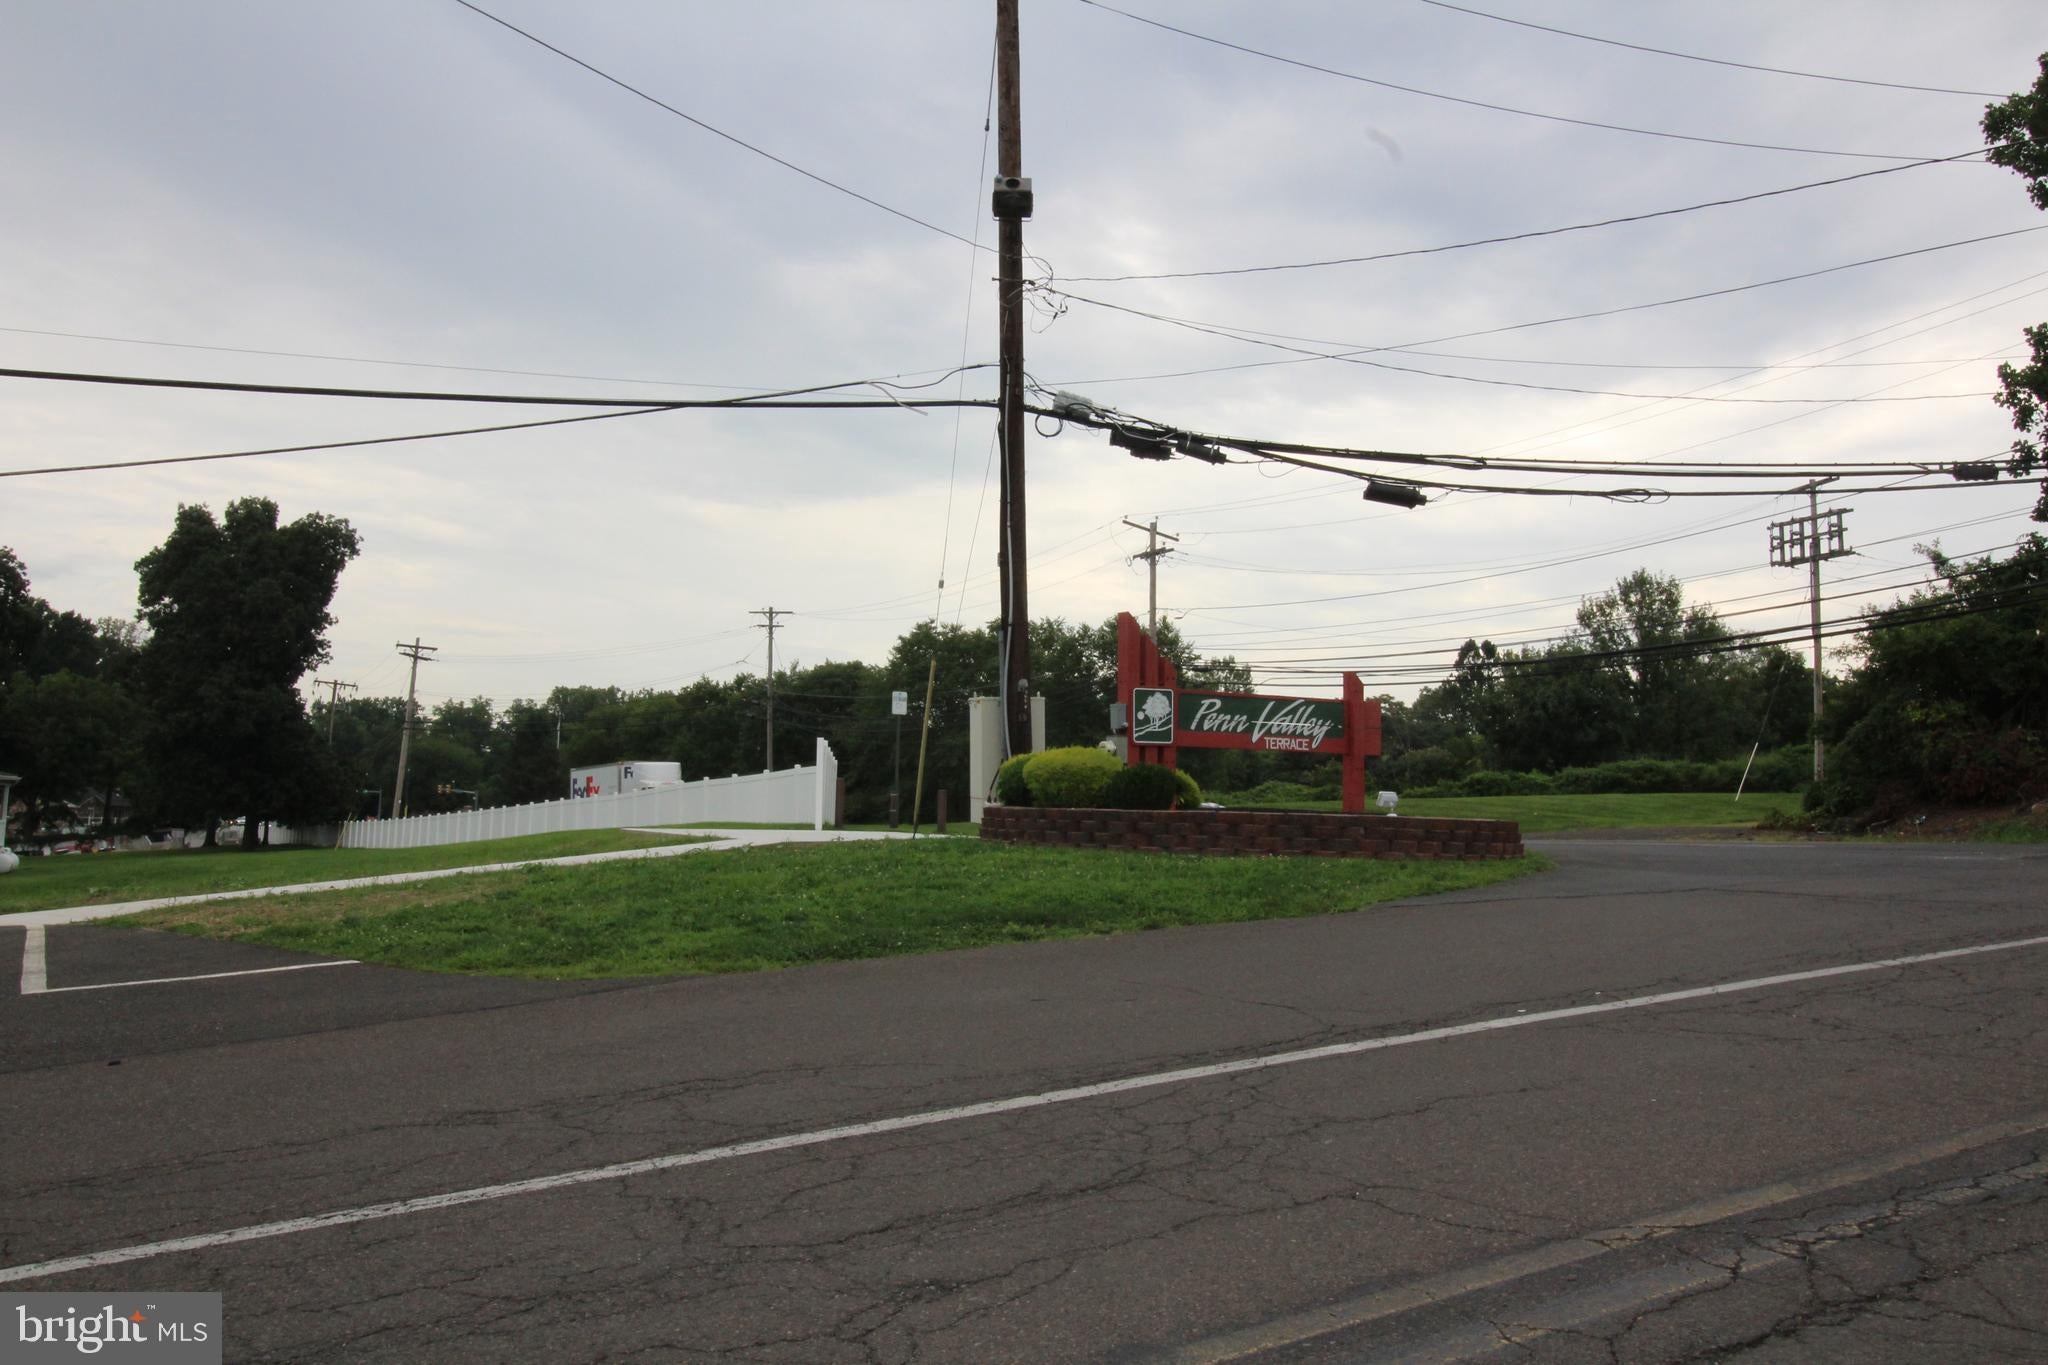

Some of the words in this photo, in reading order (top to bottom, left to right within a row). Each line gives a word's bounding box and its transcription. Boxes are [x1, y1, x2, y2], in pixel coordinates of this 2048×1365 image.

[1190, 698, 1250, 733] Penn
[1251, 699, 1333, 748] Valley
[1264, 737, 1309, 751] TERRACE
